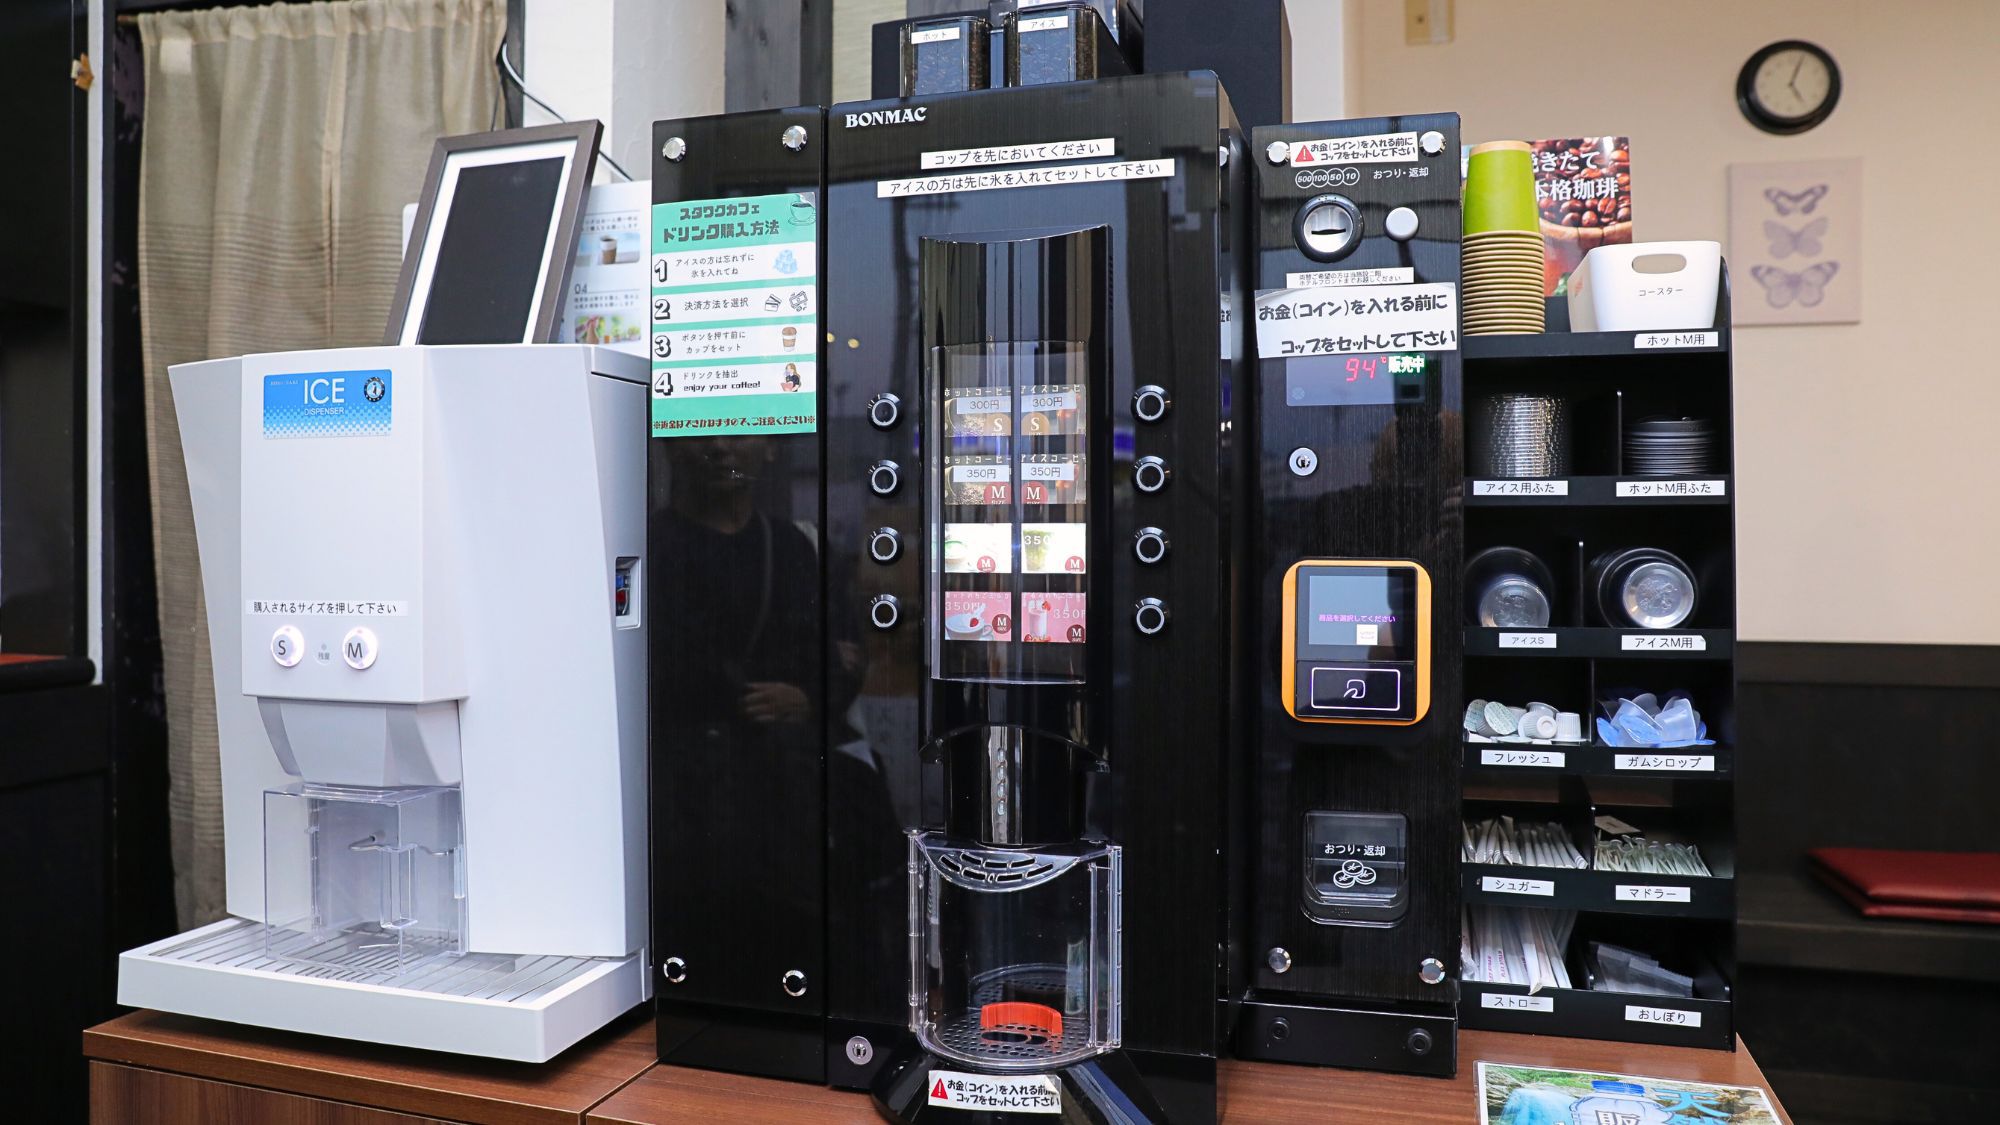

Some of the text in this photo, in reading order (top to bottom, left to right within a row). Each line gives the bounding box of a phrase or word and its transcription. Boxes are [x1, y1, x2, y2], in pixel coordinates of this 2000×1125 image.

[845, 107, 927, 128] BONMAC
[1310, 137, 1414, 153] お金(コイン)を入れる前に
[935, 143, 1101, 165] コップを先においてください
[1320, 147, 1416, 161] コップをセットして下さい
[890, 163, 1161, 195] アイスの方は先に氷を入れてセットして下さい
[1297, 172, 1357, 183] 500 100 50 10
[1373, 167, 1429, 180] おつり・返却
[679, 203, 760, 221] スタワクカフェ
[663, 219, 780, 244] ドリンク購入方法
[675, 253, 756, 267] アイスの方は忘れずに
[654, 259, 668, 283] 1
[691, 267, 739, 278] 氷を入れてね
[1638, 287, 1684, 297] コースター
[654, 298, 671, 321] 2
[684, 297, 749, 312] 決済方法を選択
[1258, 294, 1449, 321] お金(コイン)を入れる前に
[682, 330, 746, 342] ボタンを押す前に
[1281, 329, 1456, 355] コップをセットして下さい
[1647, 334, 1706, 346] ホットM用
[654, 335, 672, 358] 3
[686, 343, 741, 355] カップをセット
[1388, 356, 1425, 373] 販売中
[682, 369, 739, 381] ドリンクを抽出
[303, 377, 345, 404] ICE
[654, 372, 674, 396] 4
[683, 380, 761, 392] enjoy your coffee!
[969, 399, 1000, 410] 300円
[1032, 397, 1063, 408] 300円
[304, 407, 345, 416] DISPENSER
[993, 418, 1003, 432] S
[1030, 417, 1040, 431] S
[966, 468, 997, 479] 350円
[1030, 466, 1061, 478] 350円
[991, 485, 1006, 499] M
[1026, 486, 1041, 500] M
[1485, 482, 1555, 494] アイス用ふた
[1629, 482, 1711, 494] ホットM用ふた
[981, 559, 992, 568] M
[1070, 559, 1080, 569] M
[253, 602, 397, 615] 購入されるサイズを押して下さい
[997, 617, 1007, 627] M
[1071, 628, 1082, 638] M
[1511, 636, 1545, 645] アイスS
[1634, 637, 1693, 649] アイスM用
[277, 639, 287, 656] S
[347, 642, 364, 659] M
[1494, 753, 1552, 764] フレッシュ
[1627, 757, 1702, 769] ガムシロップ
[1324, 843, 1386, 857] おつり・返却
[1494, 879, 1542, 892] シュガー
[1629, 887, 1677, 899] マドラー
[1494, 996, 1540, 1009] ストロー
[1638, 1009, 1686, 1024] おしぼり
[956, 1093, 1060, 1107] コップをセットして下さい
